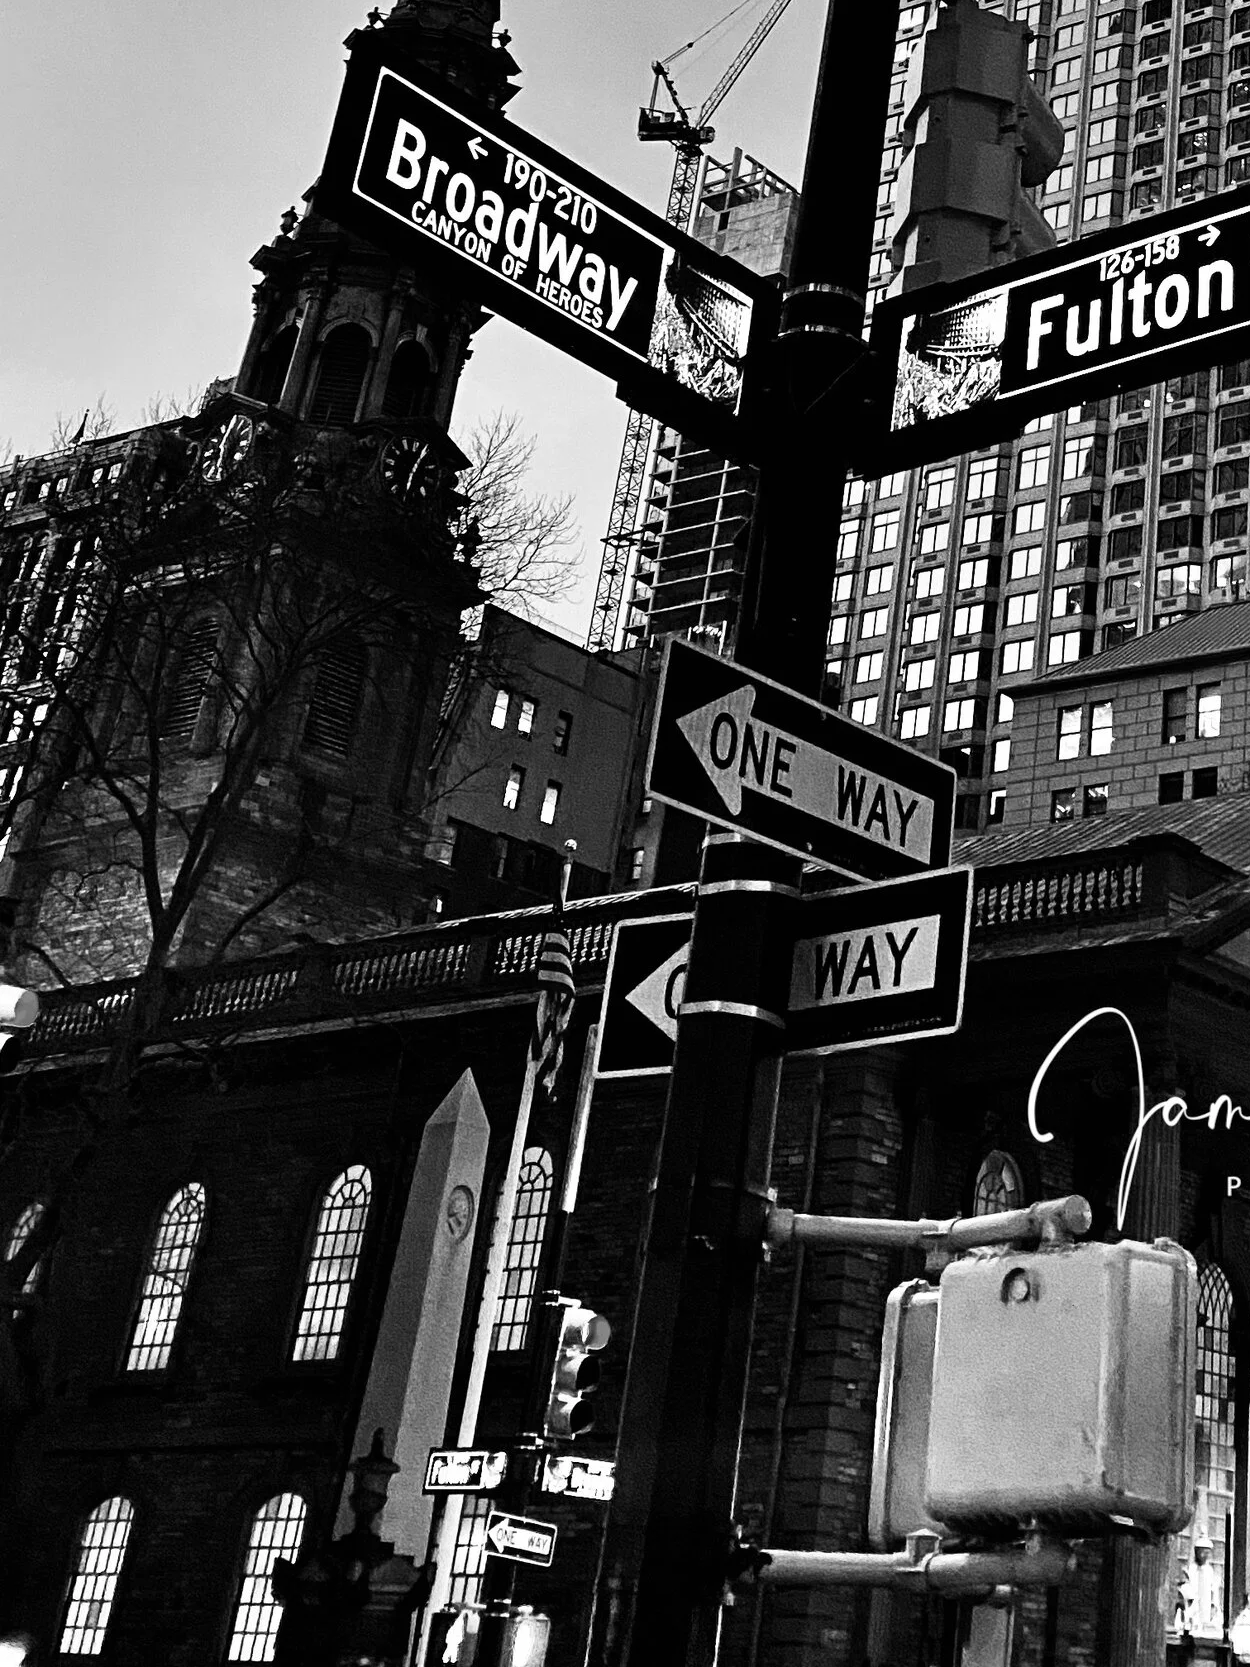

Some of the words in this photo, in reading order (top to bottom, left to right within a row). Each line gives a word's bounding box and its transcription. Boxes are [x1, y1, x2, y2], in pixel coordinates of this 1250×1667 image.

[385, 118, 639, 332] Broadway
[504, 153, 598, 234] 190-210
[411, 201, 492, 264] CANYON
[501, 253, 528, 281] OF
[535, 274, 605, 330] HEROES
[1100, 235, 1181, 282] 126-158
[1026, 259, 1235, 371] Fulton
[709, 711, 797, 799] ONE
[837, 763, 919, 848] WAY
[814, 927, 919, 1000] WAY
[496, 1527, 518, 1546] ONE
[527, 1536, 549, 1550] WAY
